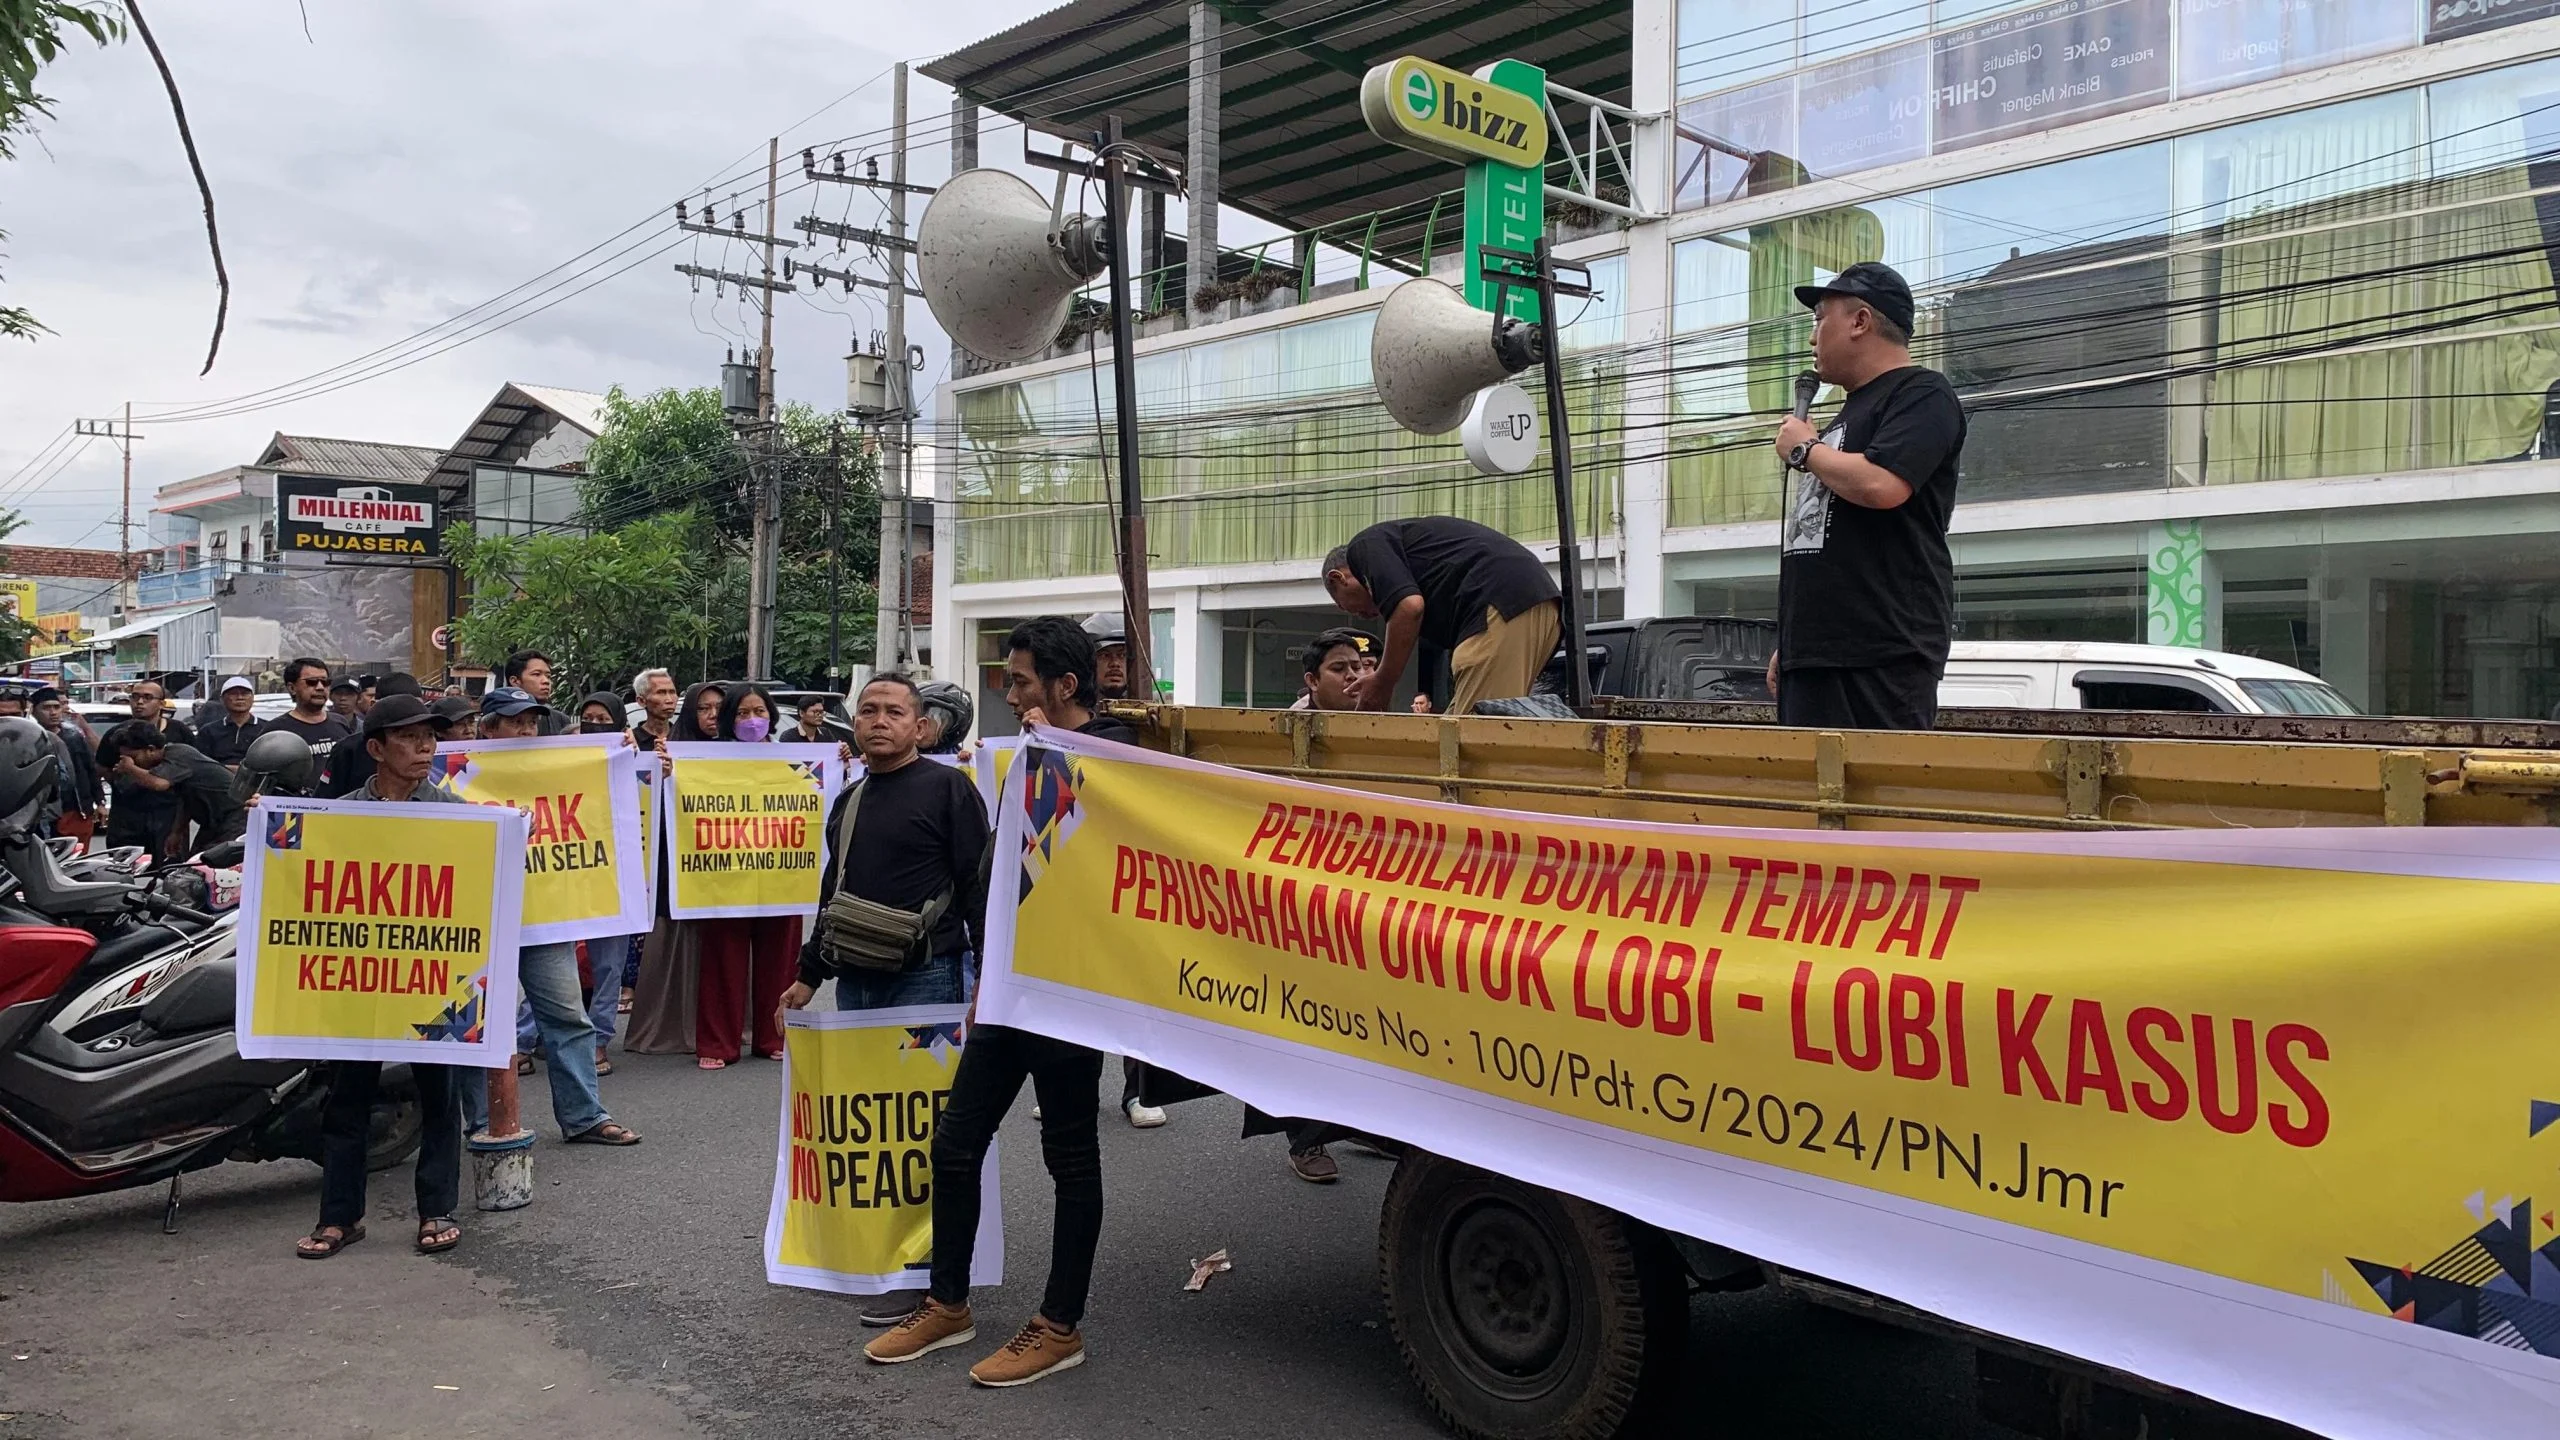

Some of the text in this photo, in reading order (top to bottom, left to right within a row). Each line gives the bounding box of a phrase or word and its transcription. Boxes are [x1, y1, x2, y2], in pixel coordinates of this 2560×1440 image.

[1503, 175, 1527, 323] HTEL
[1490, 413, 1531, 441] WAKE UP
[1490, 430, 1510, 438] COFFEE
[298, 498, 424, 522] MILLENNIAL
[345, 521, 381, 532] CAFÉ
[296, 533, 426, 553] PUJASERA
[0, 582, 29, 592] RENG
[309, 741, 337, 755] MOR
[682, 794, 818, 813] WARGA JL. MAWAR
[695, 816, 806, 851] DUKUNG
[552, 840, 609, 872] SELA
[681, 851, 816, 872] HAKIM YANG JUJUR
[303, 859, 455, 919] HAKIM
[1245, 801, 1980, 960] PENGADILAN BUKAN TEMPAT
[268, 919, 481, 953] BENTENG TERAKHIR
[298, 954, 449, 996] KEADILAN
[1112, 845, 2330, 1148] PERUSAHAAN UNTUK LOBI - LOBI KASUS
[1179, 958, 1267, 1014] Kawal
[1281, 980, 1368, 1041] Kasus
[1378, 1006, 1430, 1058] No
[1468, 1030, 2125, 1218] 100/Pdt.G/2024/PN.Jmr
[793, 1091, 813, 1141] NO
[792, 1144, 931, 1209] NO PEAC
